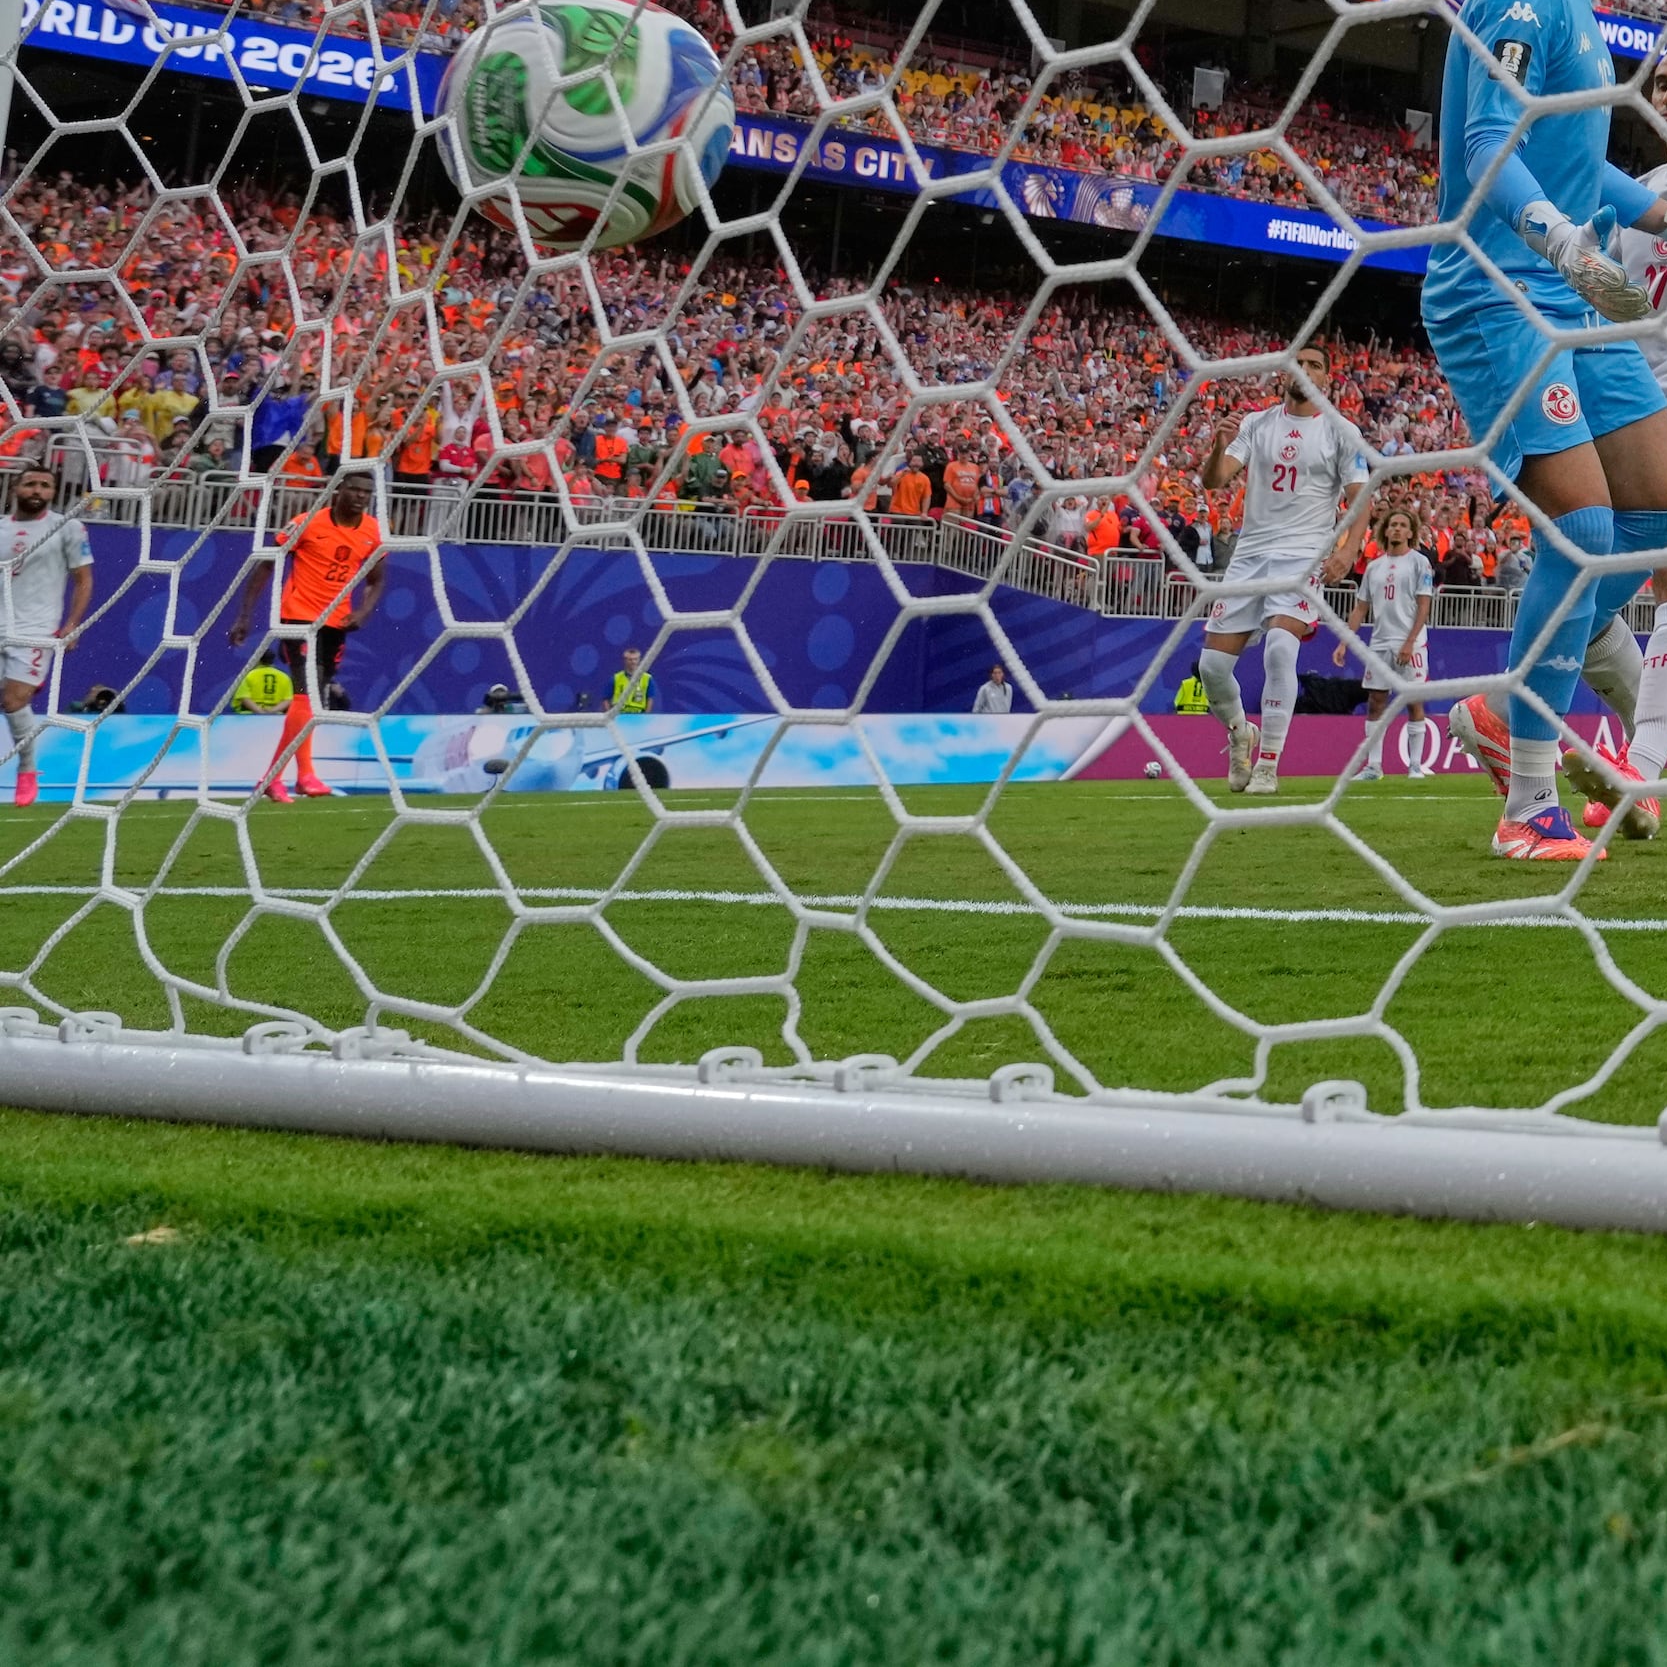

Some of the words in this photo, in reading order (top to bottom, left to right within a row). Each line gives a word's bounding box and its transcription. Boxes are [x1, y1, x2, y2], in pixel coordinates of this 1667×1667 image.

[143, 17, 236, 63] CUP
[240, 37, 396, 93] 2026
[1271, 464, 1297, 493] 21
[325, 563, 350, 582] 22
[1384, 584, 1395, 600] 10
[32, 648, 43, 668] 2
[1410, 652, 1423, 669] 10
[1265, 698, 1283, 708] FTF
